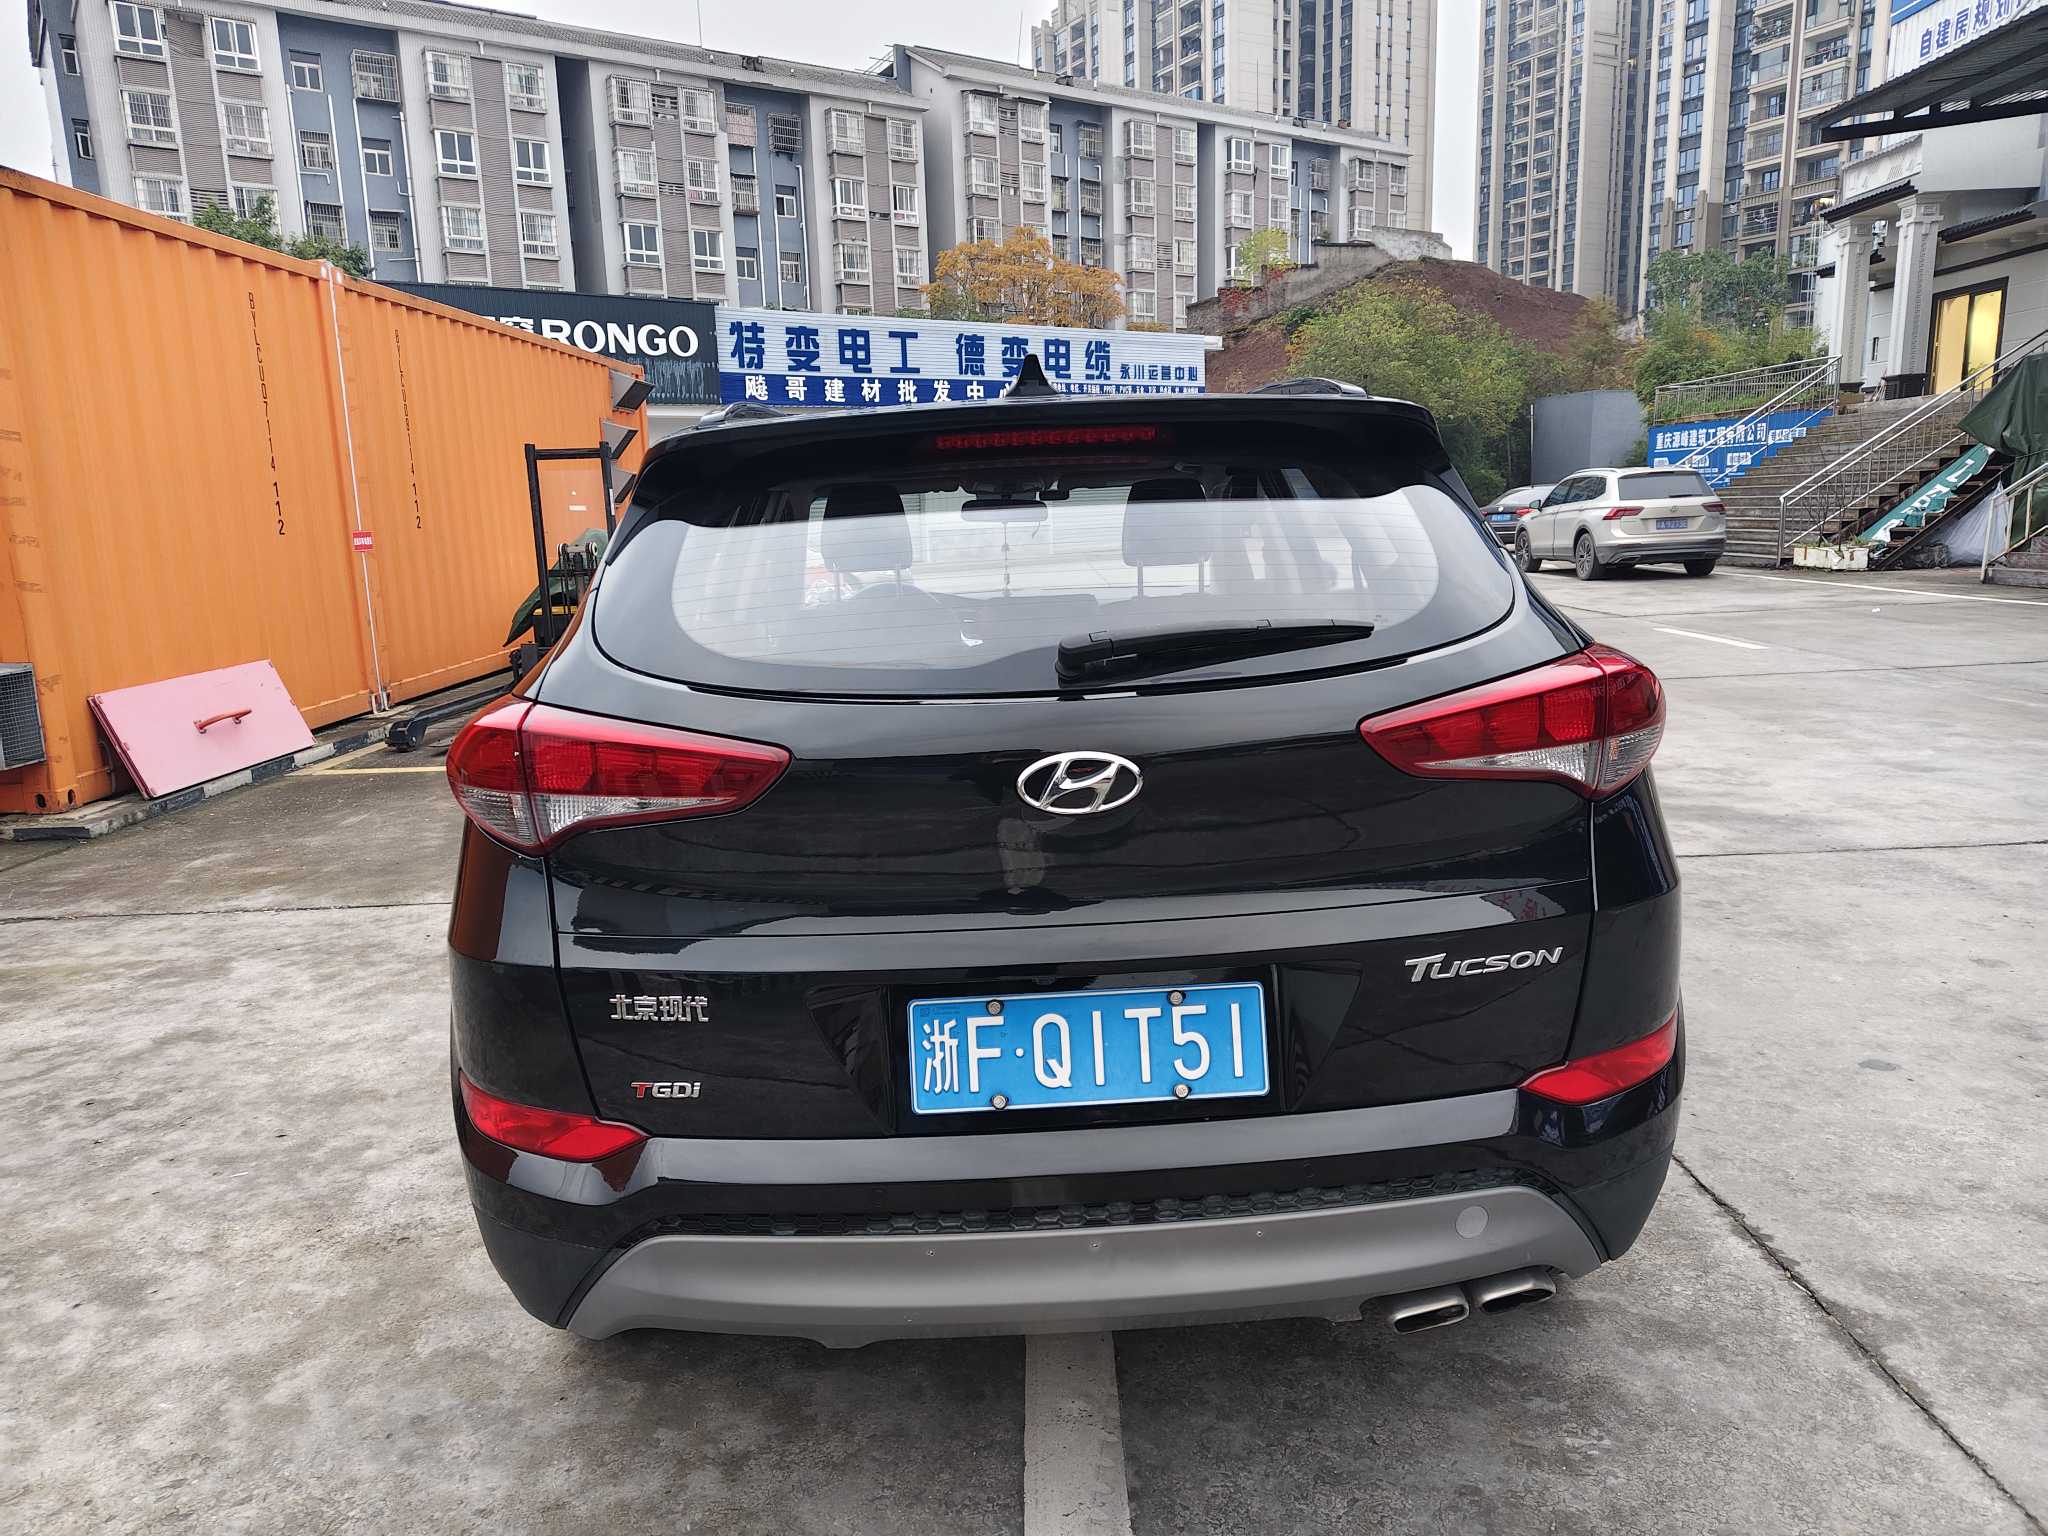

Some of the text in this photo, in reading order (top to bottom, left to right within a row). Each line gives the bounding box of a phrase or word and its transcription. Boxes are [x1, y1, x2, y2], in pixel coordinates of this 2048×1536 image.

[1920, 0, 2021, 58] 自建房规划
[541, 318, 699, 358] RONGO
[729, 320, 1111, 381] 特变电工 德变电缆
[1405, 946, 1564, 982] TUCSON
[609, 994, 709, 1022] 北京现代
